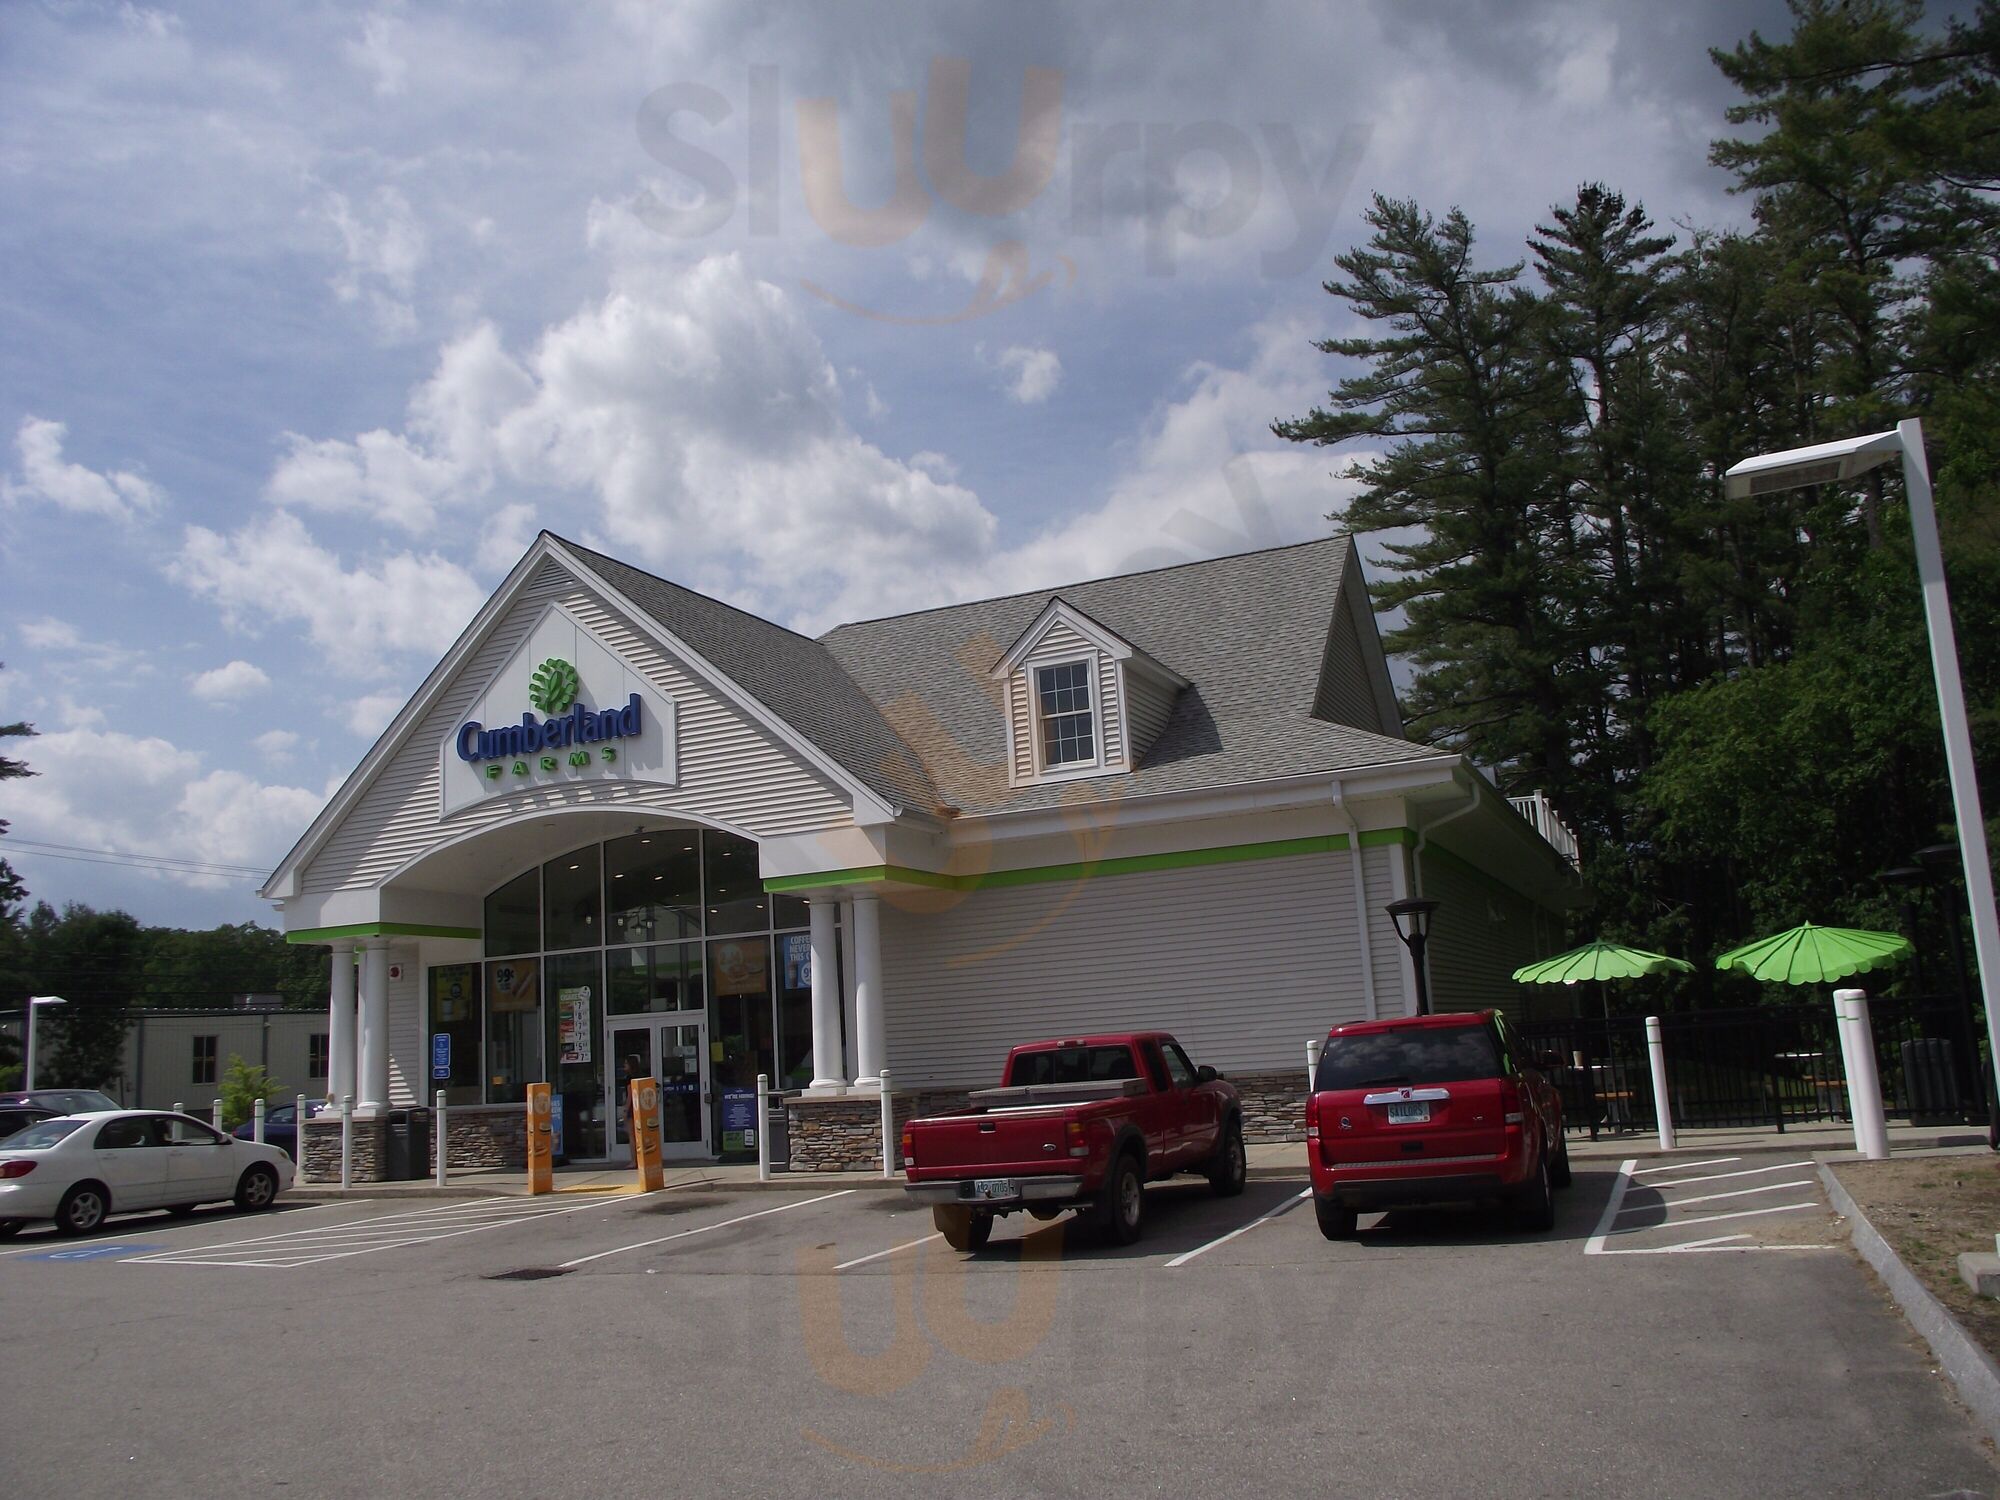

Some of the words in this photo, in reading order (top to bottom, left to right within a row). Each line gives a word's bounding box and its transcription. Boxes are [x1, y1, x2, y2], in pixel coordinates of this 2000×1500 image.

[457, 693, 641, 762] Cumberland
[486, 746, 616, 779] FARMS
[790, 935, 810, 944] COFFE
